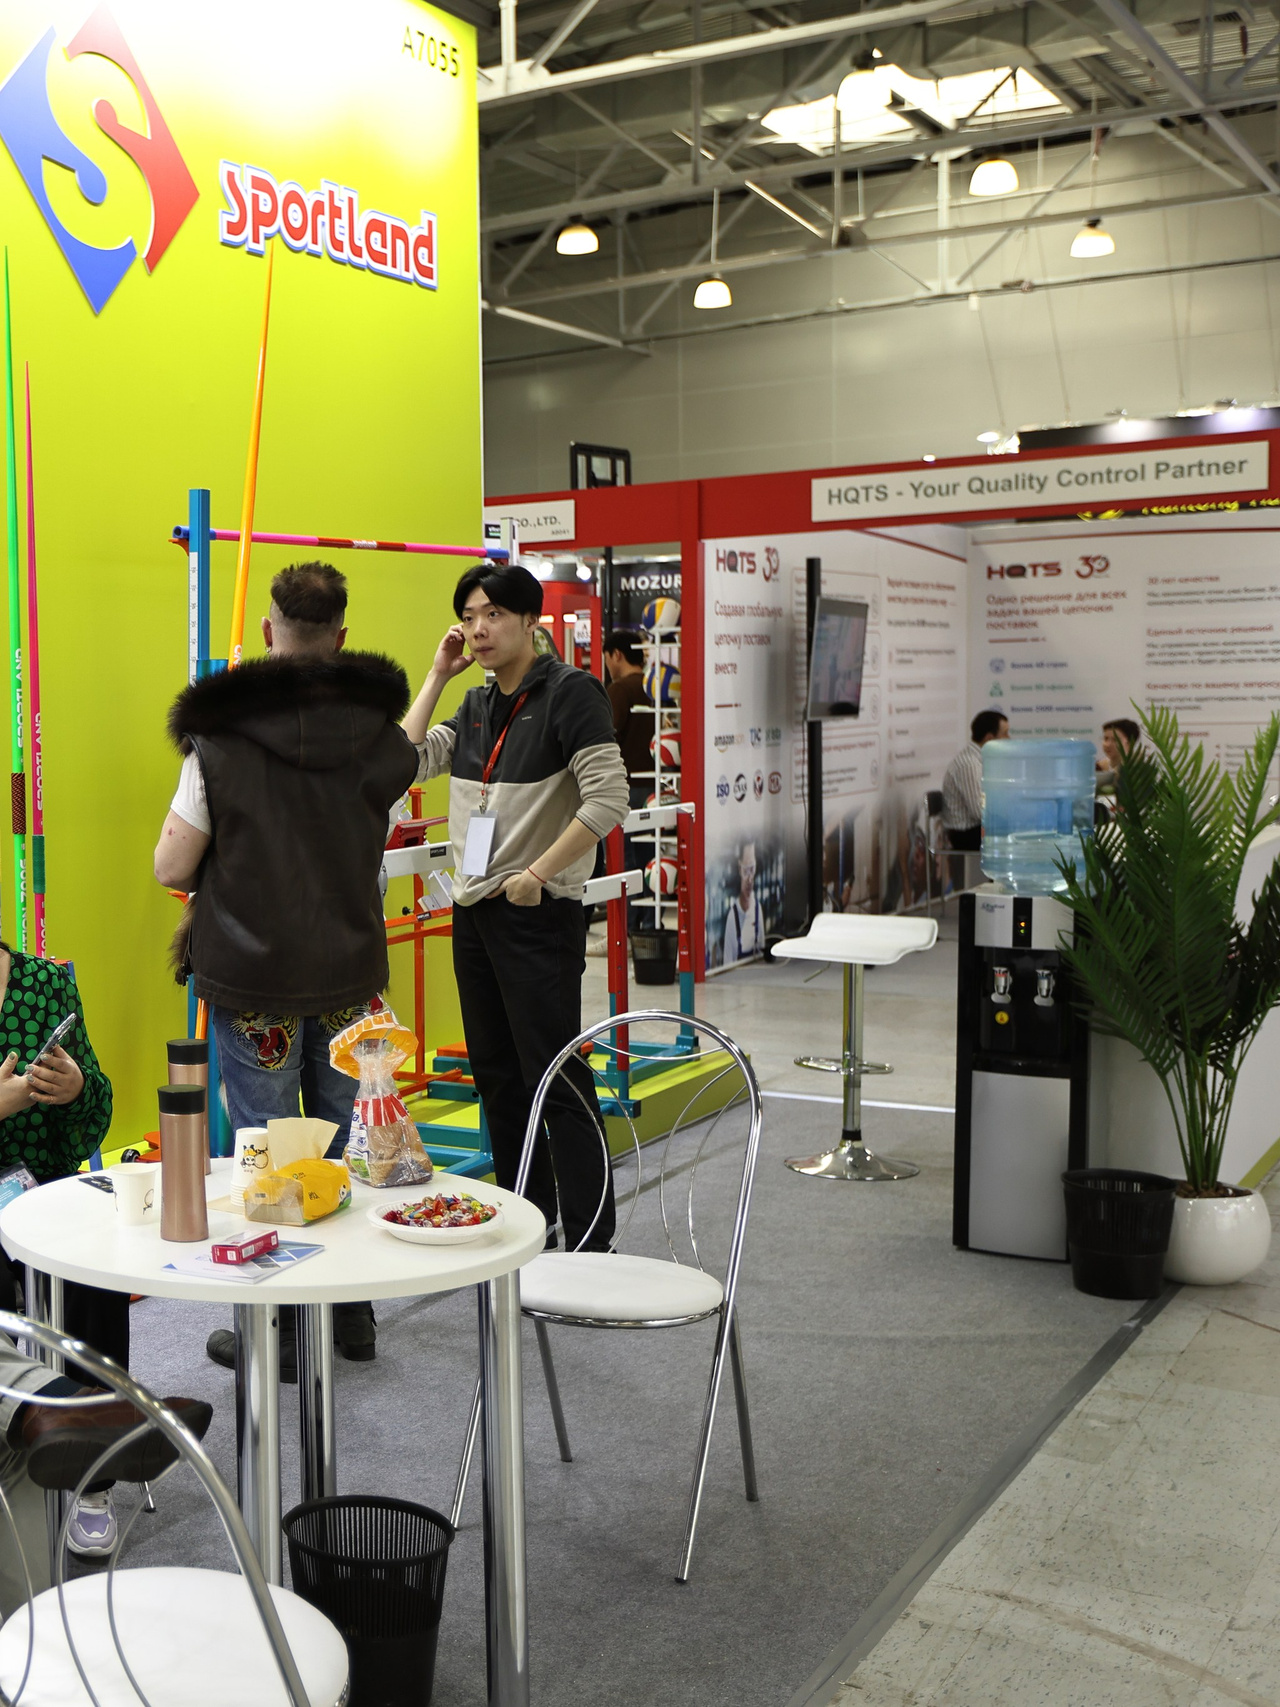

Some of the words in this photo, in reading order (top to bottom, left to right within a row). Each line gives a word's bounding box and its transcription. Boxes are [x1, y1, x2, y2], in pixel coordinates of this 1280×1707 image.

[402, 25, 459, 77] A7055
[827, 484, 889, 506] HQTS
[910, 479, 961, 500] Your
[967, 472, 1049, 496] Quality
[1056, 462, 1146, 488] Control
[1155, 456, 1249, 481] Partner
[715, 550, 757, 574] HQTS
[986, 561, 1062, 580] HQTS
